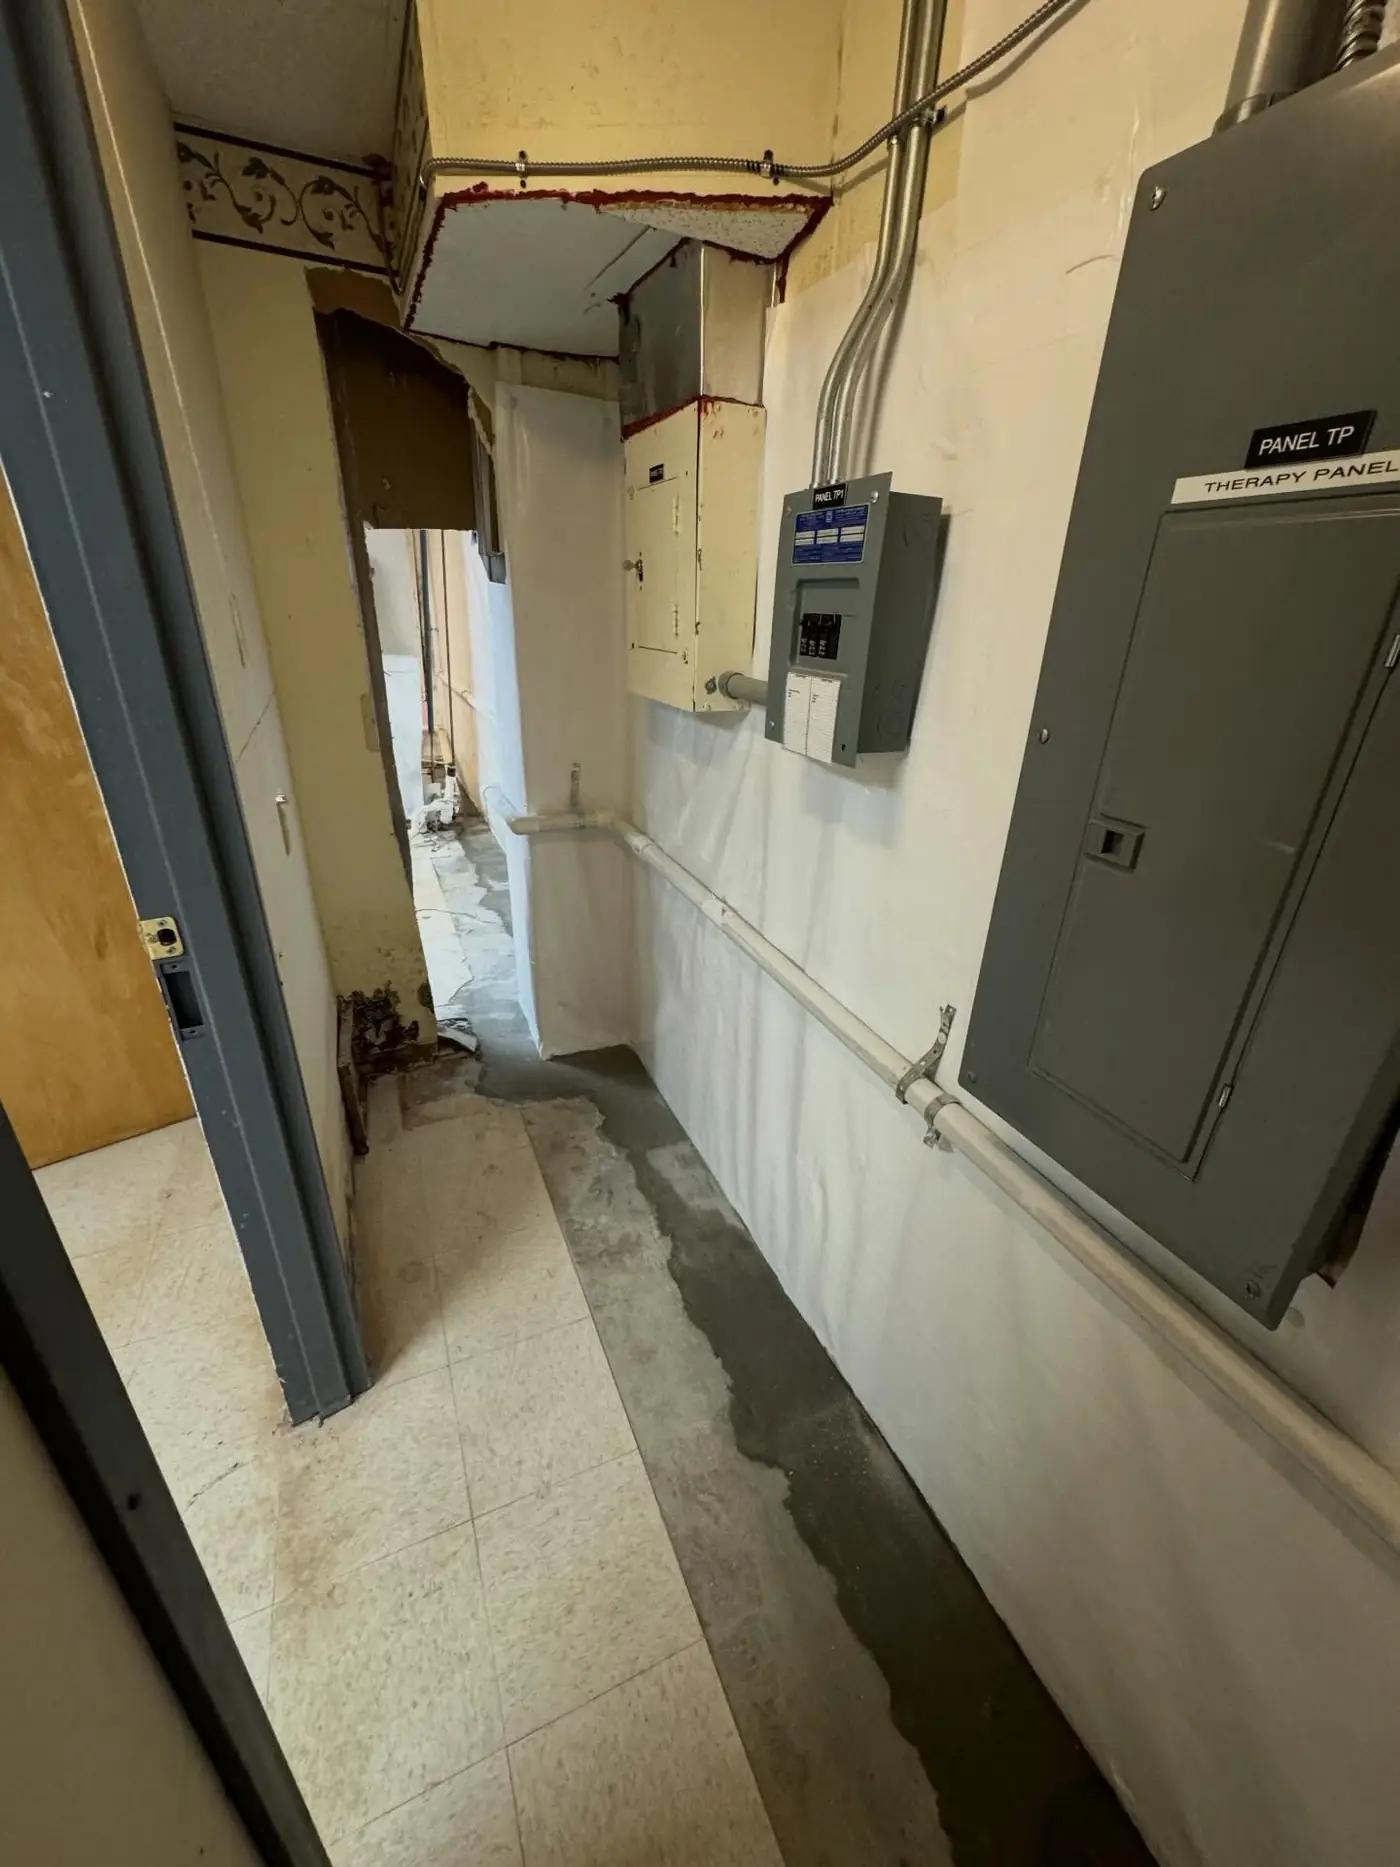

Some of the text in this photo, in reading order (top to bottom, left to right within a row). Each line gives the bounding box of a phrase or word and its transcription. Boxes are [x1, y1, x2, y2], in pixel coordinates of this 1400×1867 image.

[1258, 425, 1355, 456] PANEL TP
[1204, 461, 1399, 493] THERAPY PANEL
[815, 488, 844, 503] PANEL TP1
